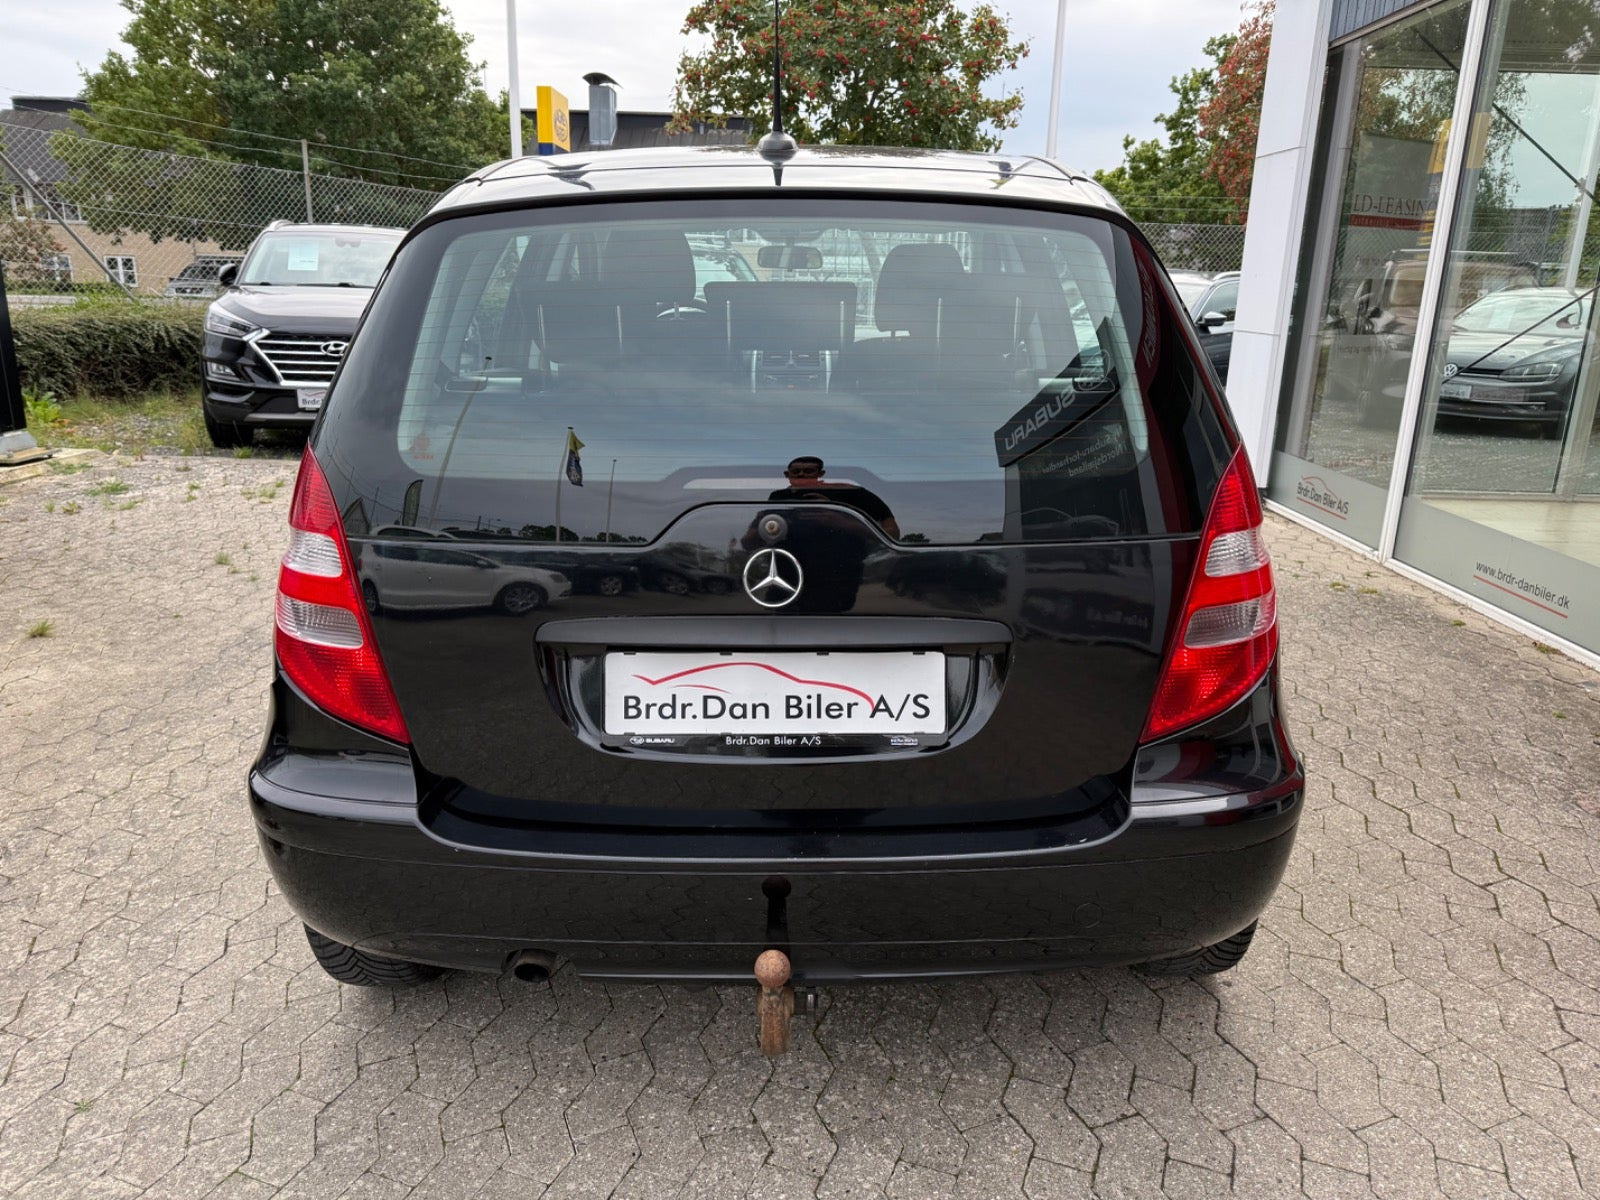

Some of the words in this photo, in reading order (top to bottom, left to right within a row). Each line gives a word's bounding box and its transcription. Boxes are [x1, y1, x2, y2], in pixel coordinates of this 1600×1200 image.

[1476, 562, 1570, 610] www.brdr-danbiler.dk
[623, 694, 770, 720] Brdr.Dan
[785, 694, 859, 719] Biler
[869, 693, 931, 721] A/S
[725, 735, 771, 746] Brdr.Dan
[773, 735, 798, 746] Biler
[800, 735, 823, 747] A/S
